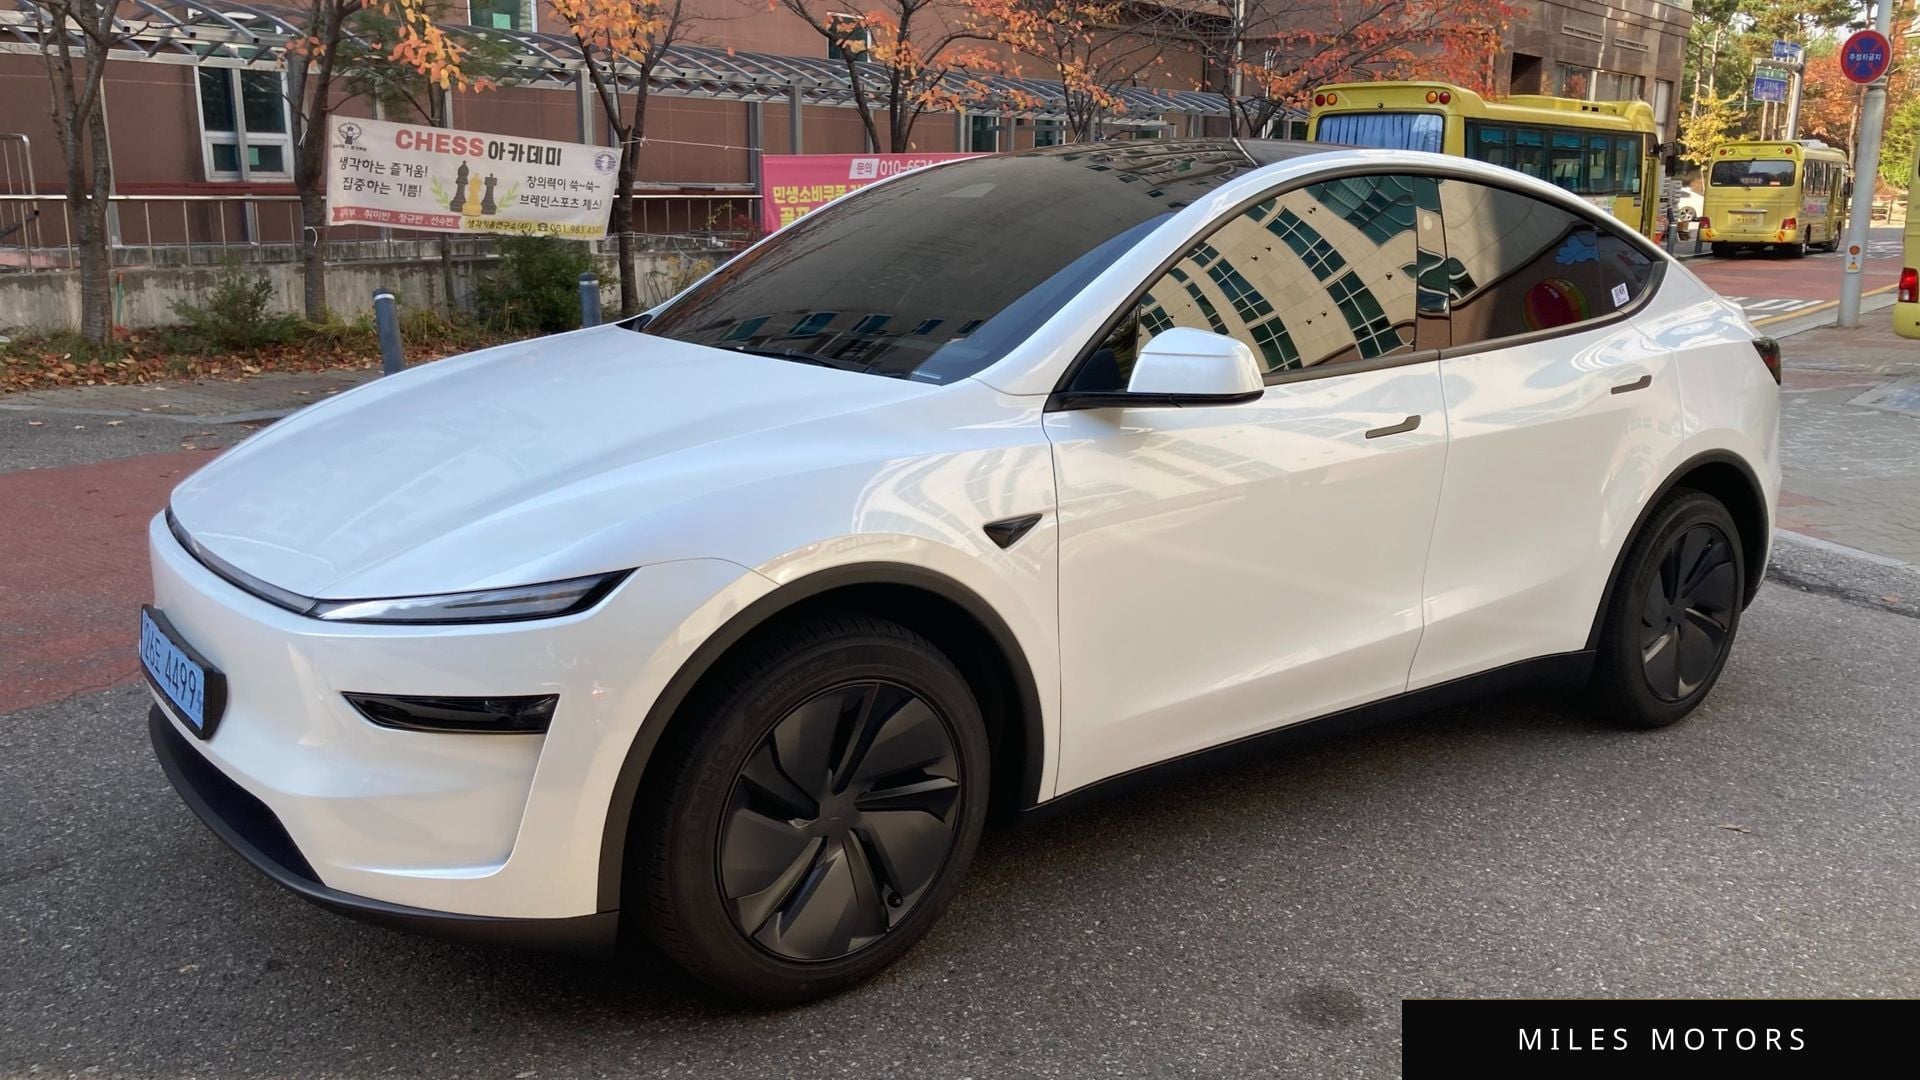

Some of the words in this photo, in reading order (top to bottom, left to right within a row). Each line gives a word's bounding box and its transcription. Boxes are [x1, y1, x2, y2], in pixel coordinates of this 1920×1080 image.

[395, 129, 485, 158] CHESS
[488, 141, 562, 166] 아카데미
[340, 156, 386, 175] 생각하는
[390, 162, 428, 178] 즐거움!
[856, 162, 873, 176] 문의
[343, 177, 391, 195] 집중하는
[396, 183, 422, 198] 기쁨!
[527, 176, 566, 190] 창의력이
[520, 194, 579, 208] 브레인스포츠
[364, 210, 390, 221] 취미반
[399, 213, 423, 224] 정규반
[431, 217, 455, 226] 선수반
[165, 649, 197, 710] 4499
